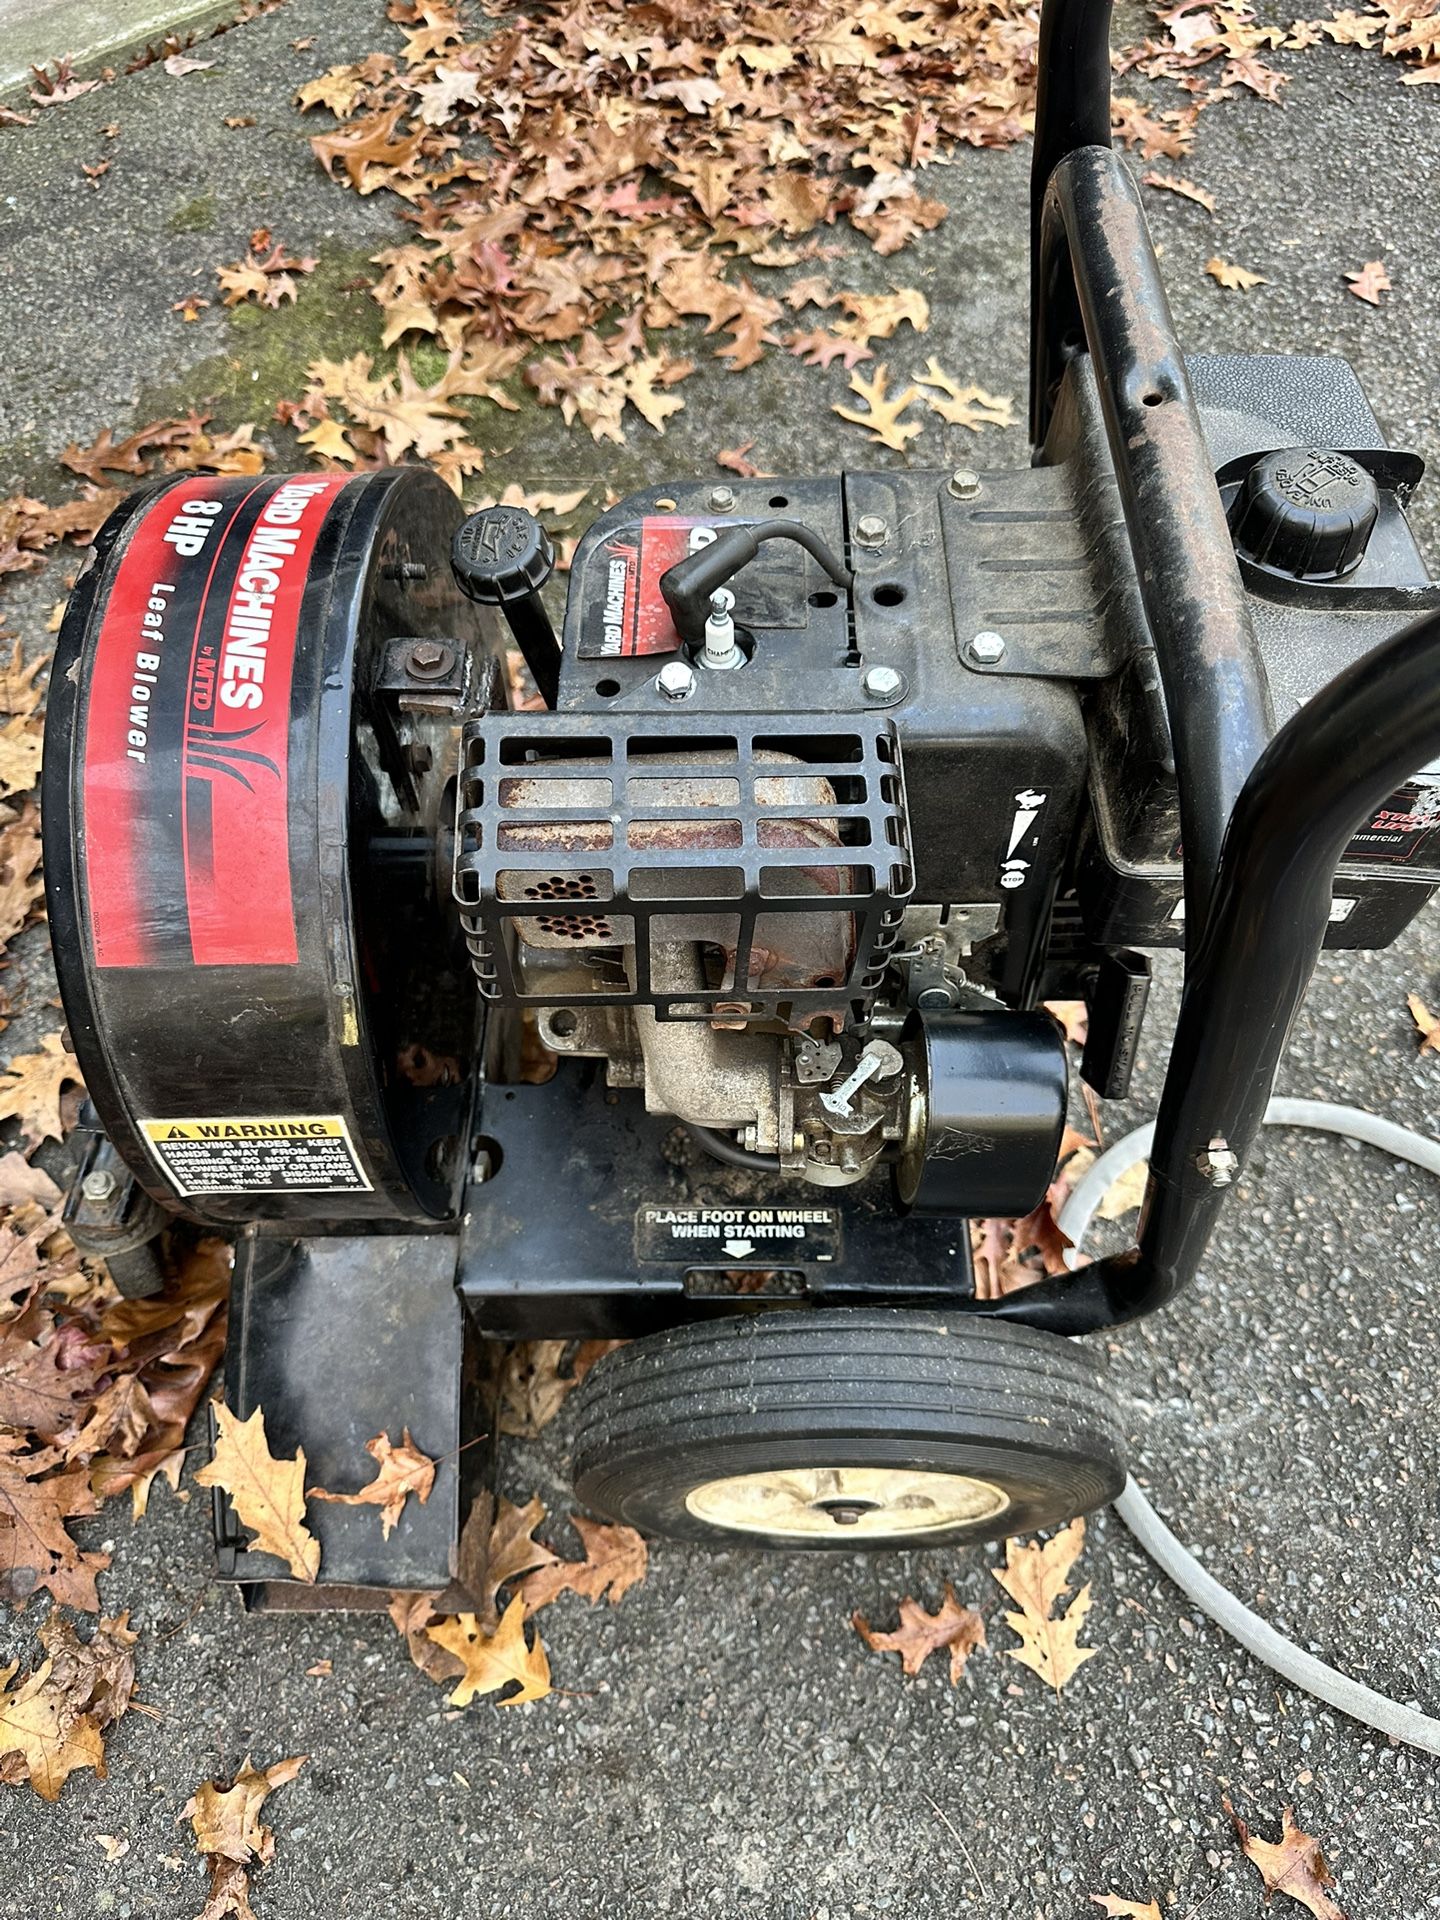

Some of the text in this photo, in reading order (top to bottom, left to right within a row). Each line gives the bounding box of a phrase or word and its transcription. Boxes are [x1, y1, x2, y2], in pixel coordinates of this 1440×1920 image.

[220, 483, 329, 710] YARD MACHINES
[600, 560, 627, 656] YARD MACHINES
[127, 582, 176, 764] Leaf Blower
[193, 645, 216, 711] by MTD
[197, 1123, 328, 1137] WARNING
[160, 1140, 234, 1151] REVOLVING
[239, 1140, 291, 1149] BLADES
[307, 1138, 342, 1147] KEEP
[165, 1147, 346, 1159] HANDS AWAY FROM ALL
[170, 1154, 349, 1166] OPENINGS. DO NOT REMOVE
[174, 1161, 352, 1173] BLOWER EXHAUST OR STAND
[179, 1172, 193, 1180] IN
[202, 1171, 244, 1179] FRONT
[281, 1169, 355, 1178] DISCHARGE
[185, 1178, 220, 1186] AREA
[231, 1177, 272, 1185] WHILE
[285, 1176, 333, 1184] ENGINE
[645, 1210, 832, 1224] PLACE FOOT ON WHEEL
[671, 1225, 806, 1238] WHEN STARTING
